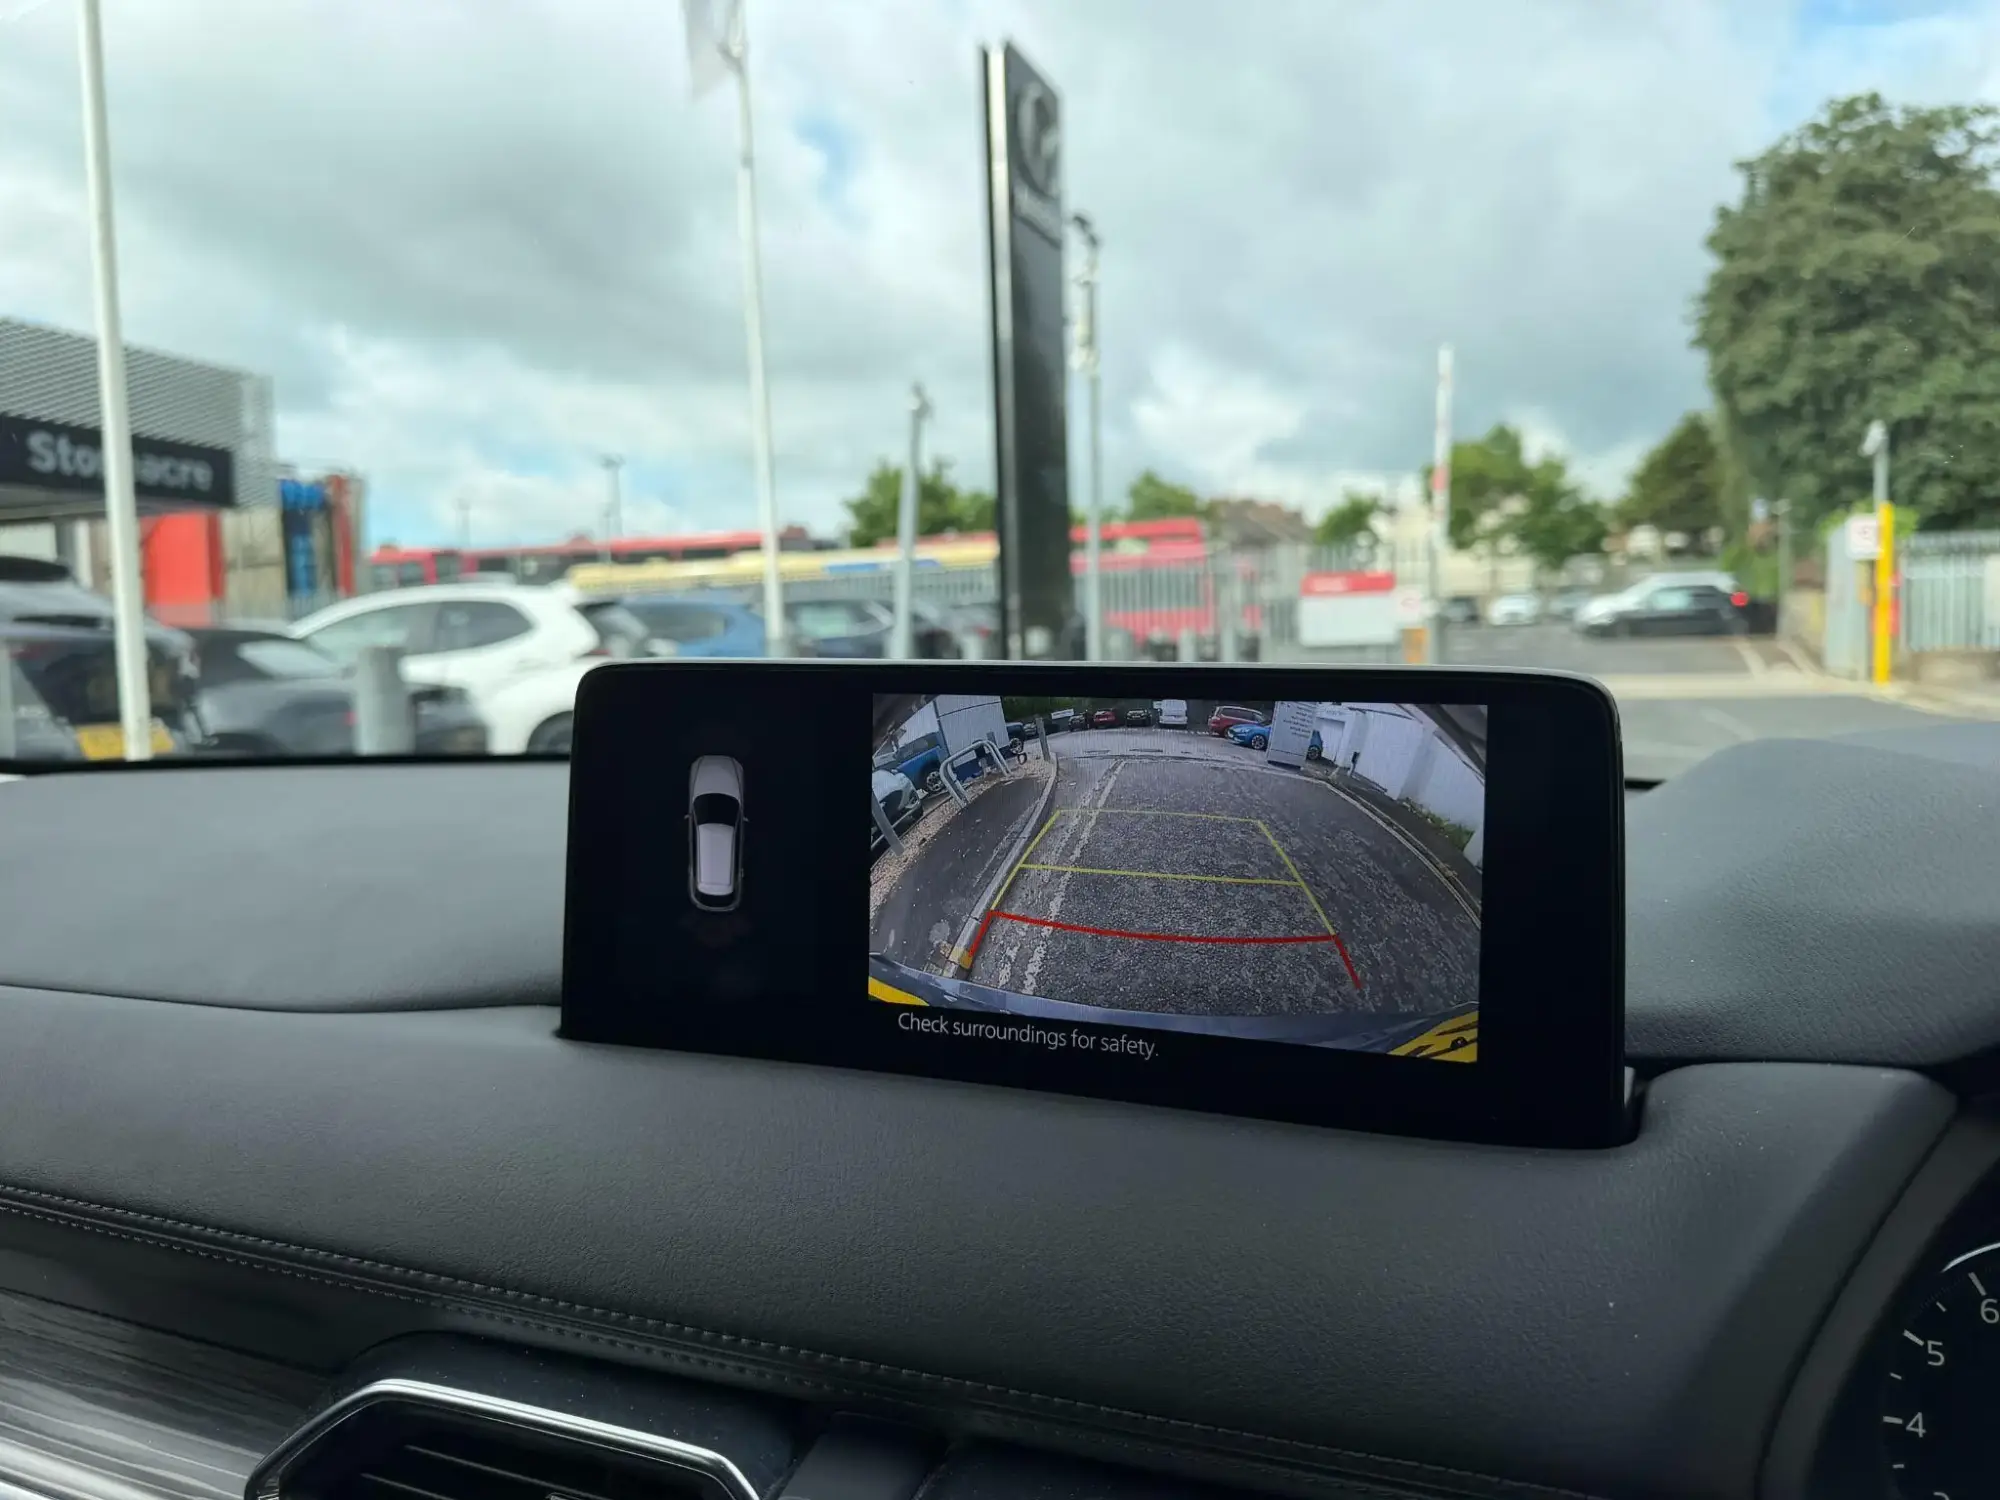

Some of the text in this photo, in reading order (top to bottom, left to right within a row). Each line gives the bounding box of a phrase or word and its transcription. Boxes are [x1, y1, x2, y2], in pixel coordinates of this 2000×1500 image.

[27, 430, 213, 491] Stoacre
[898, 1012, 1159, 1061] Check surroundings for safety.
[1980, 1298, 2000, 1323] 6
[1927, 1340, 1945, 1366] 5
[1905, 1412, 1926, 1438] 4
